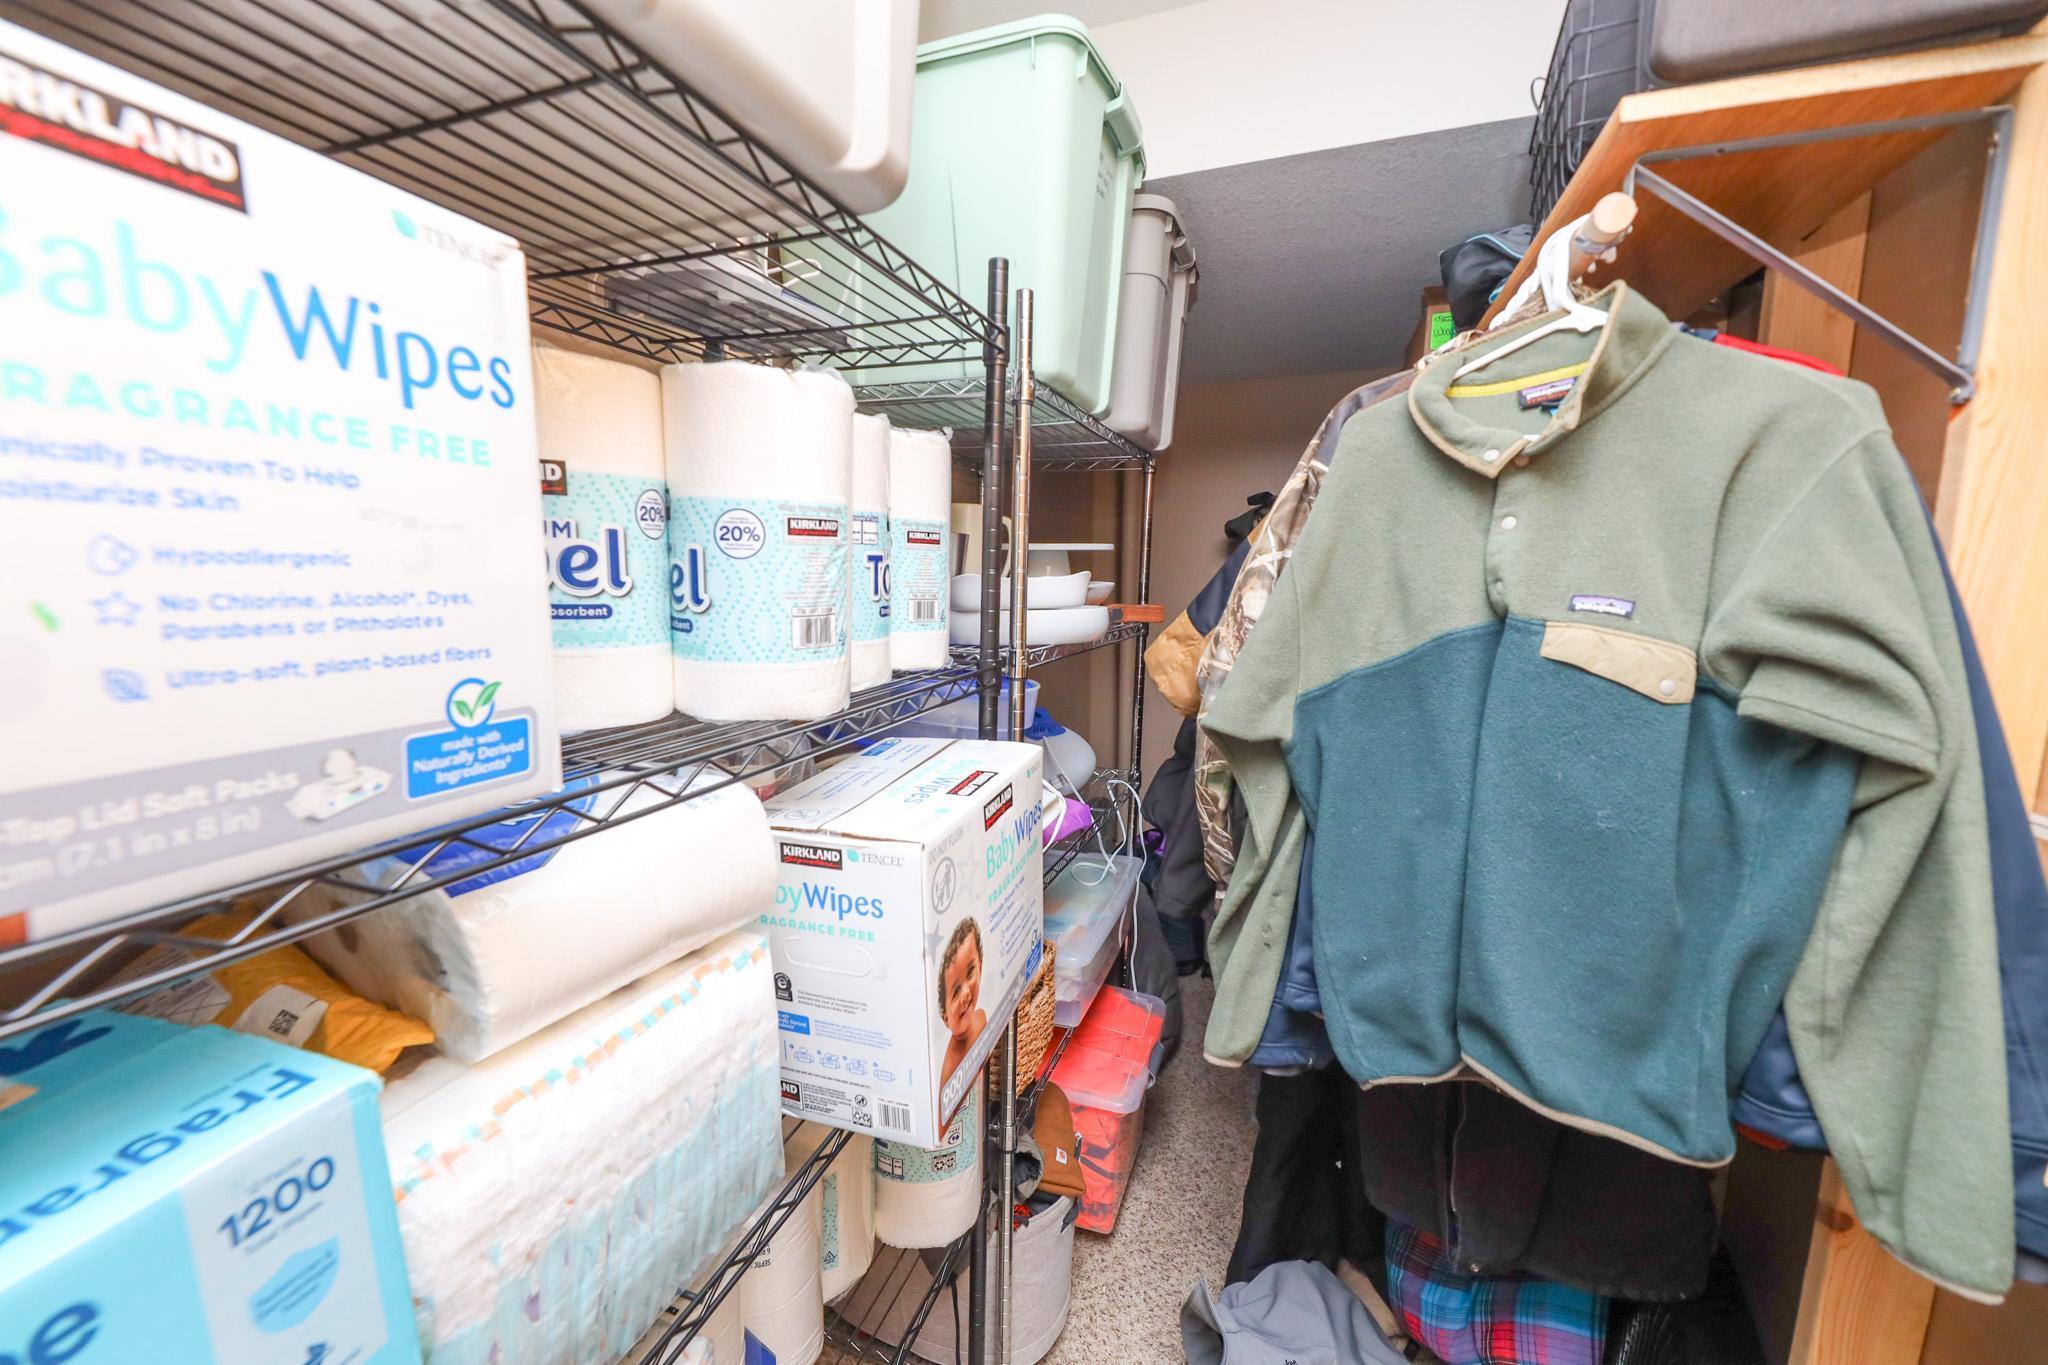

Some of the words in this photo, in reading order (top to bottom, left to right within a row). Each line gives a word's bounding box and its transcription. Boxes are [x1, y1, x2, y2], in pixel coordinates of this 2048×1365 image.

[391, 424, 491, 467] FREE
[140, 445, 257, 479] Proven
[265, 460, 297, 484] To
[304, 465, 361, 491] Help
[639, 505, 665, 523] 20%
[719, 525, 761, 542] 20%
[789, 518, 838, 532] KIRKLAND
[152, 547, 352, 569] Hypoallergenic
[159, 594, 200, 612] No
[427, 591, 475, 608] Dyes,
[162, 621, 295, 641] Parabens
[303, 620, 327, 635] or
[314, 650, 441, 678] plant-based
[446, 646, 492, 663] fibers
[477, 730, 501, 745] with
[412, 749, 475, 774] Naturally
[477, 737, 525, 760] Derived
[141, 784, 210, 818] Soft
[215, 770, 300, 802] Packs
[782, 844, 841, 862] KIRKLAND
[839, 928, 876, 942] FREE
[217, 1155, 335, 1248] 1200
